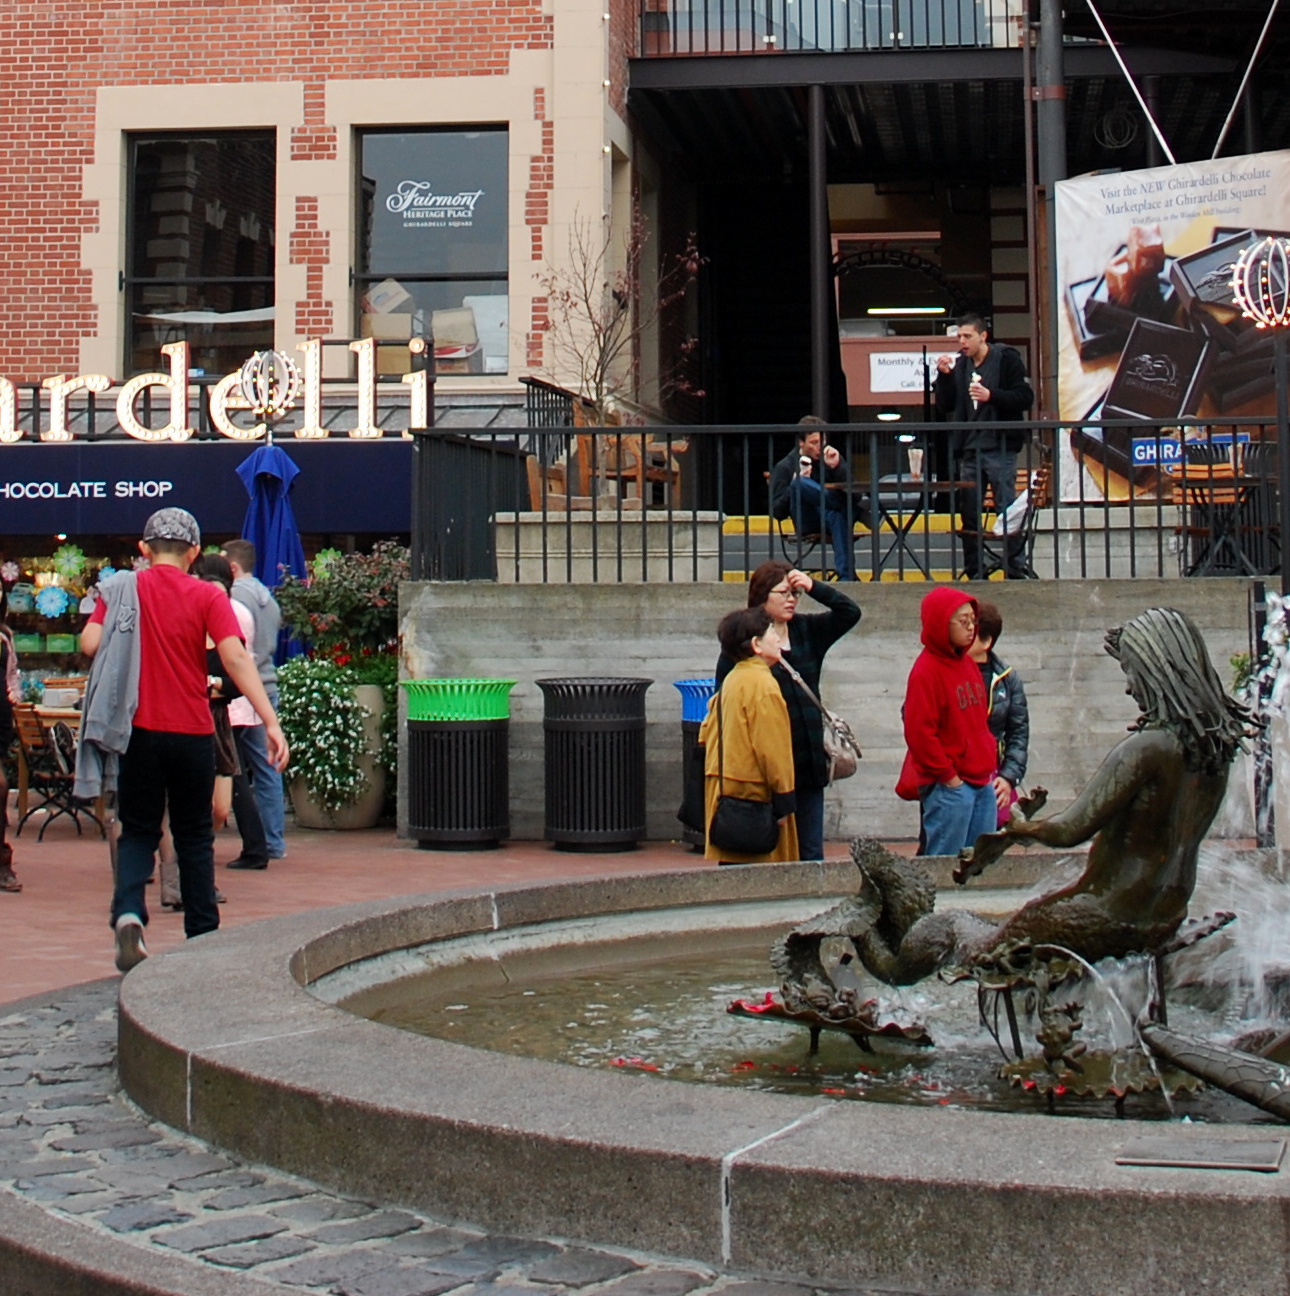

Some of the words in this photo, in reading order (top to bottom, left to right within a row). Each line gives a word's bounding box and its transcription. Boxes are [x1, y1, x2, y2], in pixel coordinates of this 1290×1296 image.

[386, 180, 485, 213] Fairmont
[1100, 186, 1121, 200] Visit
[1123, 185, 1137, 197] the
[1140, 180, 1166, 195] NEW
[1167, 172, 1220, 191] Ghirardelli
[1221, 167, 1271, 183] Chocolate
[1105, 199, 1162, 216] Marketplace
[1164, 198, 1174, 208] at
[1175, 188, 1228, 207] Ghirardelli
[1229, 185, 1267, 202] Square!
[877, 357, 914, 367] Monthly
[115, 480, 173, 498] SHOP
